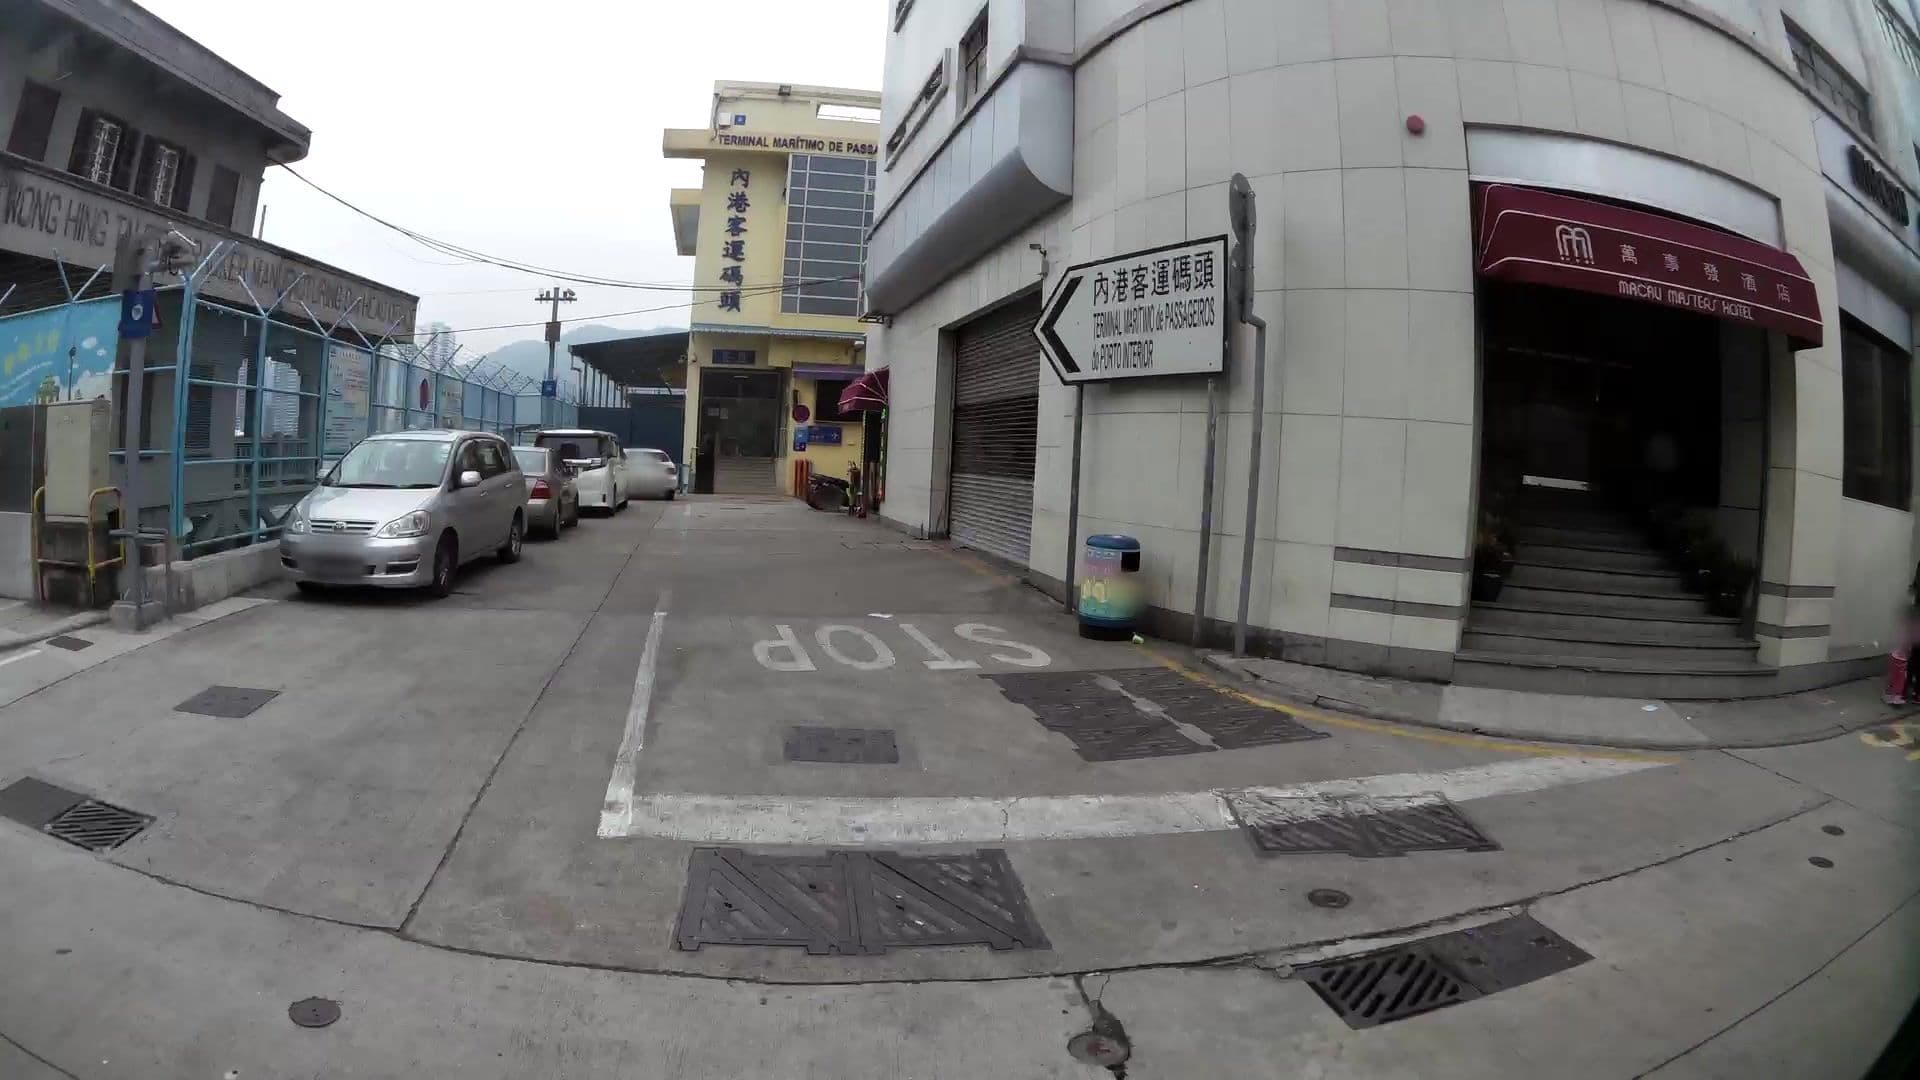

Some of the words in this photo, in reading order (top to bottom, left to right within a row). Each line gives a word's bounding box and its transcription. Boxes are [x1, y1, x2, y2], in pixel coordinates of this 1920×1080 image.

[718, 134, 769, 148] TERMINAL
[773, 135, 824, 152] MARÍTIMO
[829, 140, 843, 153] DE
[1619, 243, 1791, 303] 萬事發酒店
[1093, 309, 1122, 339] TERMINAL
[1165, 296, 1215, 330] PASSAGEIROS
[1618, 280, 1663, 301] MACAU
[1667, 288, 1717, 312] MASTERS
[1721, 300, 1755, 321] HOTEL
[1101, 343, 1121, 370] PORTO
[1123, 340, 1153, 369] INTERIOR
[752, 622, 1051, 672] STOP
